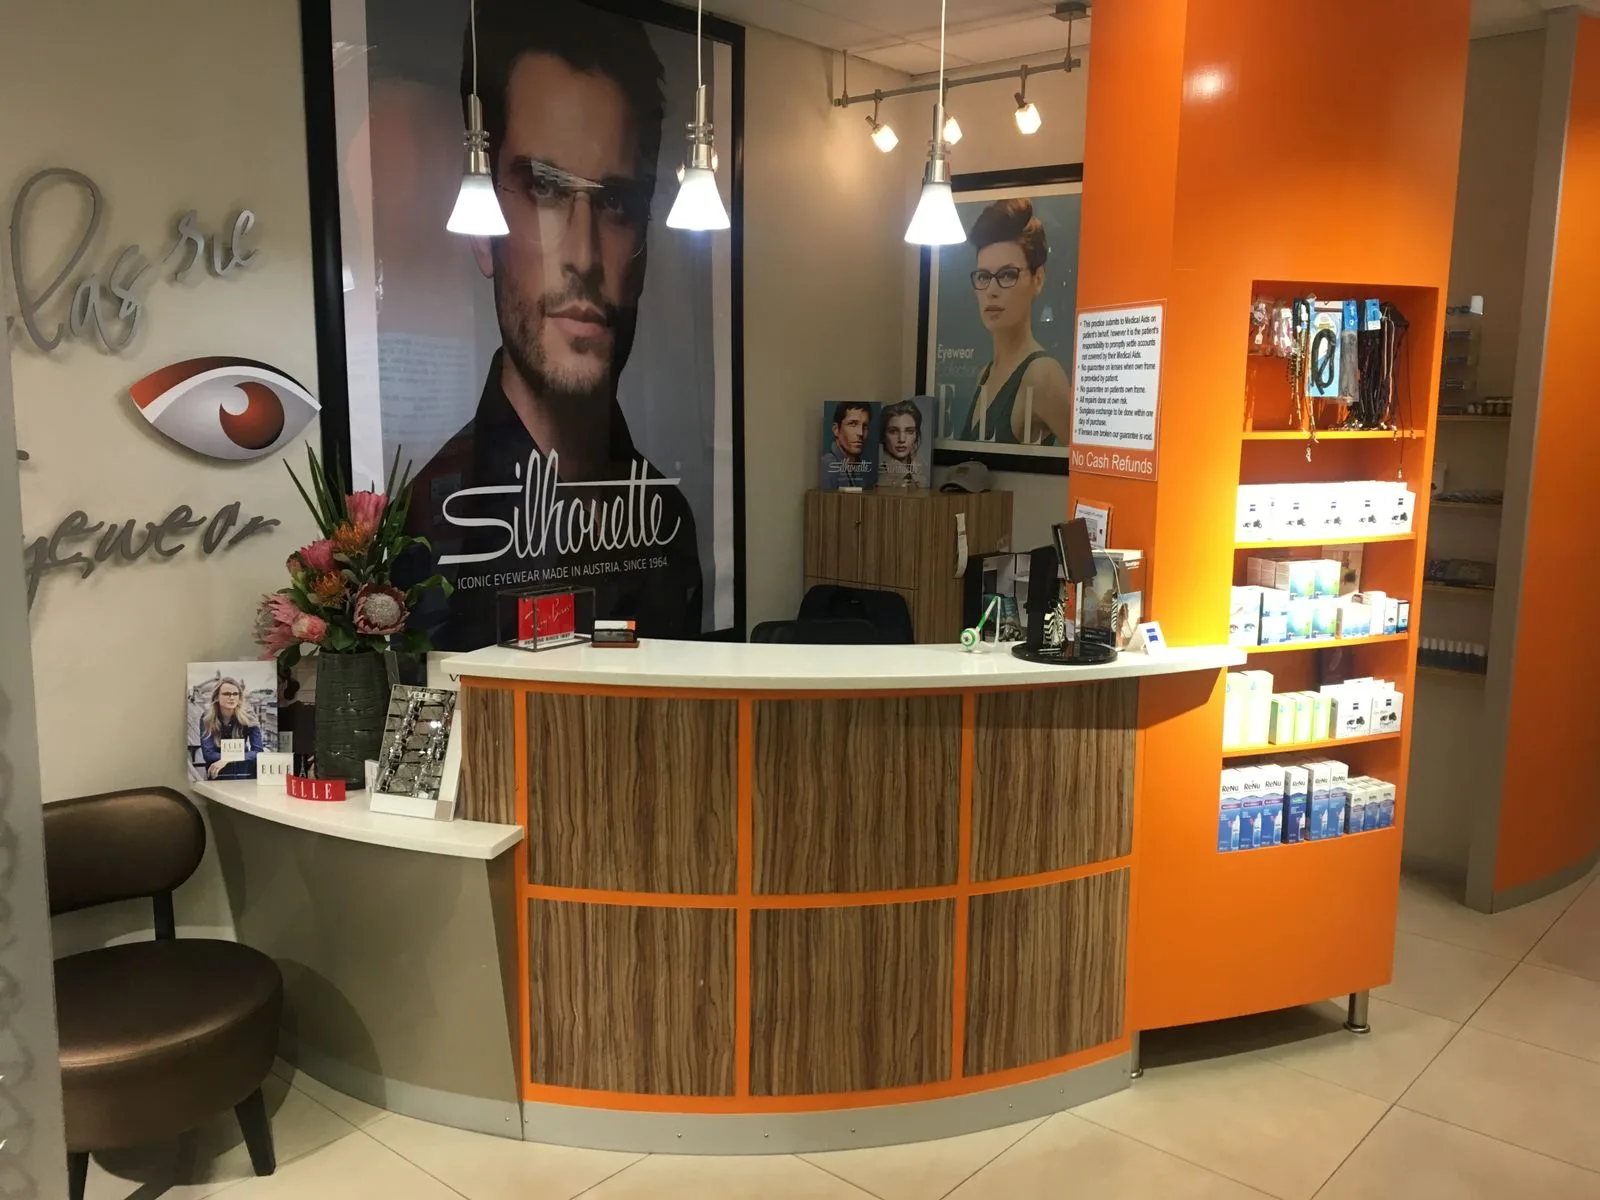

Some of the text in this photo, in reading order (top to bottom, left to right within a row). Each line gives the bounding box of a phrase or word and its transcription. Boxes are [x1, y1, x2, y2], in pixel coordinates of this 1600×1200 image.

[938, 344, 974, 361] Eyewear
[937, 383, 1043, 445] ELL
[1096, 408, 1112, 416] exchange
[828, 458, 872, 473] Silhouette
[1072, 451, 1152, 474] No Cash Refunds
[437, 448, 681, 565] Silhouette
[23, 500, 281, 613] yewear
[457, 575, 491, 590] ICONIC
[494, 570, 539, 585] EYEWEAR
[542, 566, 569, 581] MADE
[571, 566, 581, 576] IN
[583, 560, 622, 575] AUSTRIA.
[623, 559, 647, 571] SINCE
[262, 764, 291, 775] ELLE
[292, 779, 332, 800] ELLE
